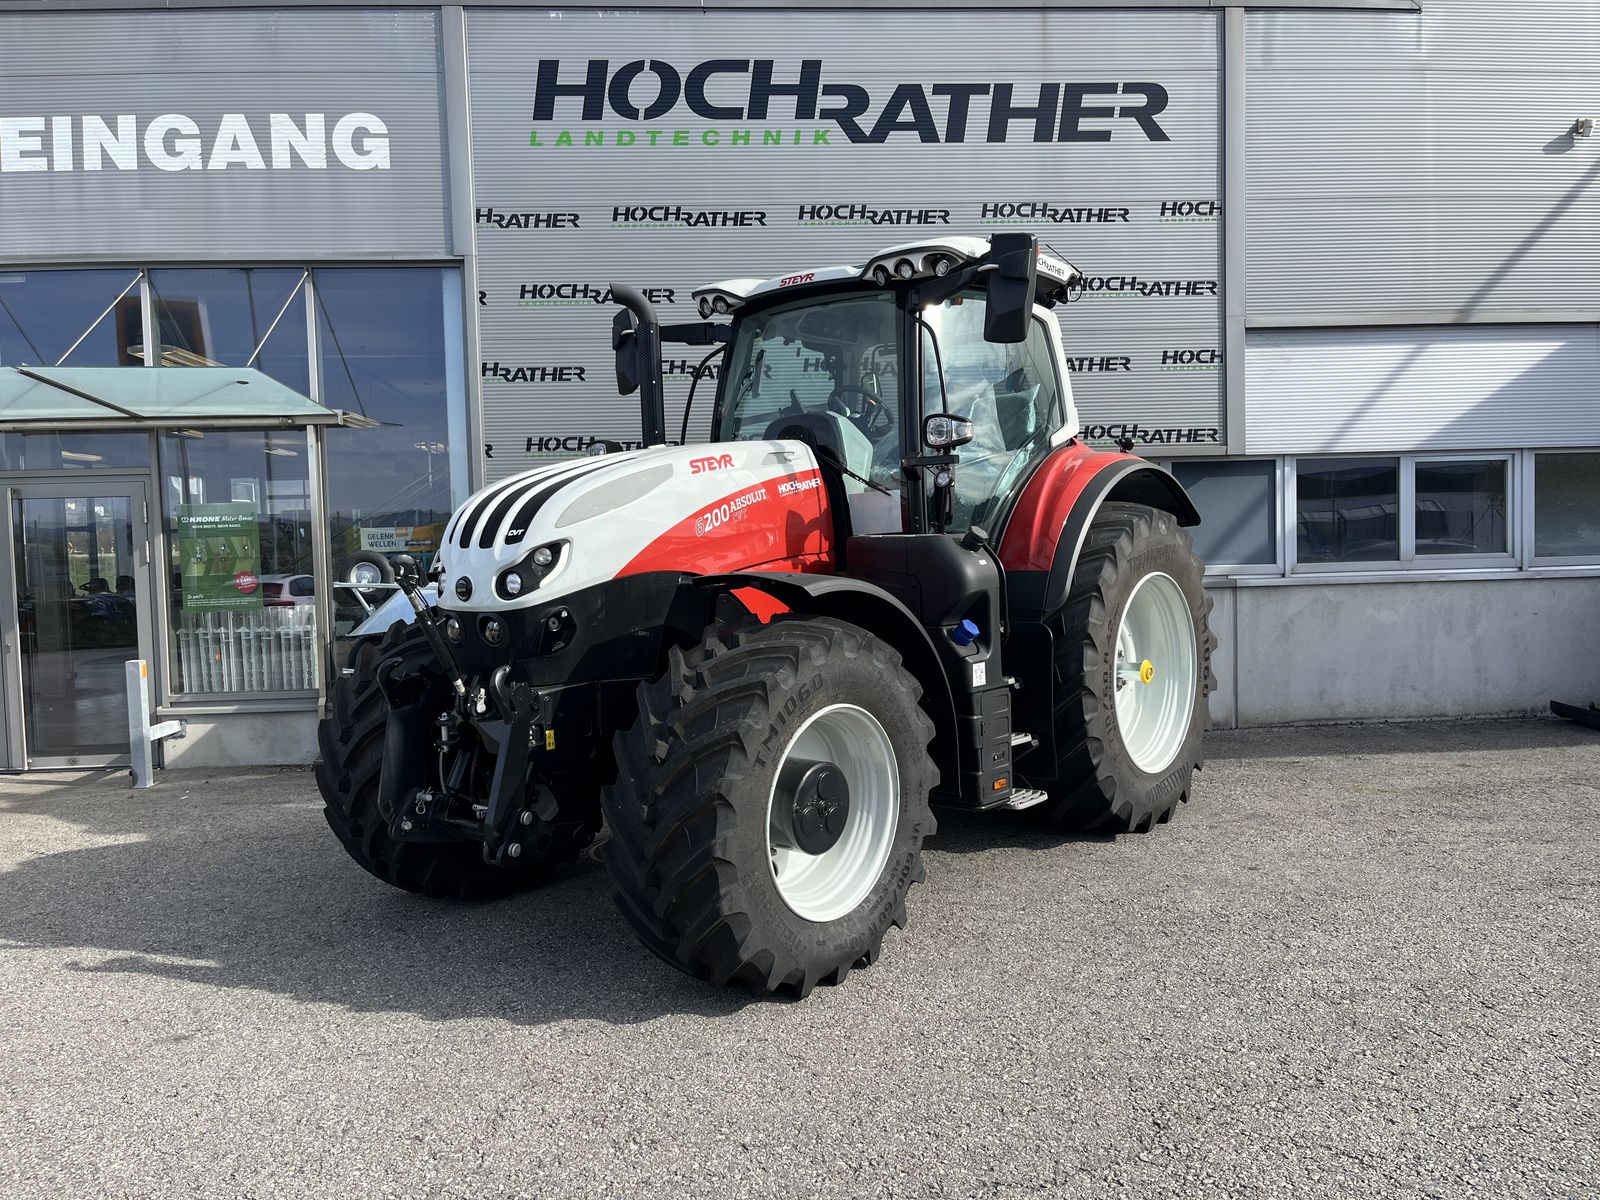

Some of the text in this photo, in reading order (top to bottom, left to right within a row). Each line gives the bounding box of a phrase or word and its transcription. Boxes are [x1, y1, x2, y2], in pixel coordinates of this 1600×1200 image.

[0, 112, 391, 172] EINGANG
[529, 129, 832, 147] LANDTECHNIK
[780, 272, 814, 288] STEYR
[689, 454, 735, 475] STEYR
[695, 488, 768, 538] 6200 ABSOLUT
[508, 529, 525, 537] CVT
[367, 540, 397, 548] WELLEN
[752, 672, 823, 769] TM1060
